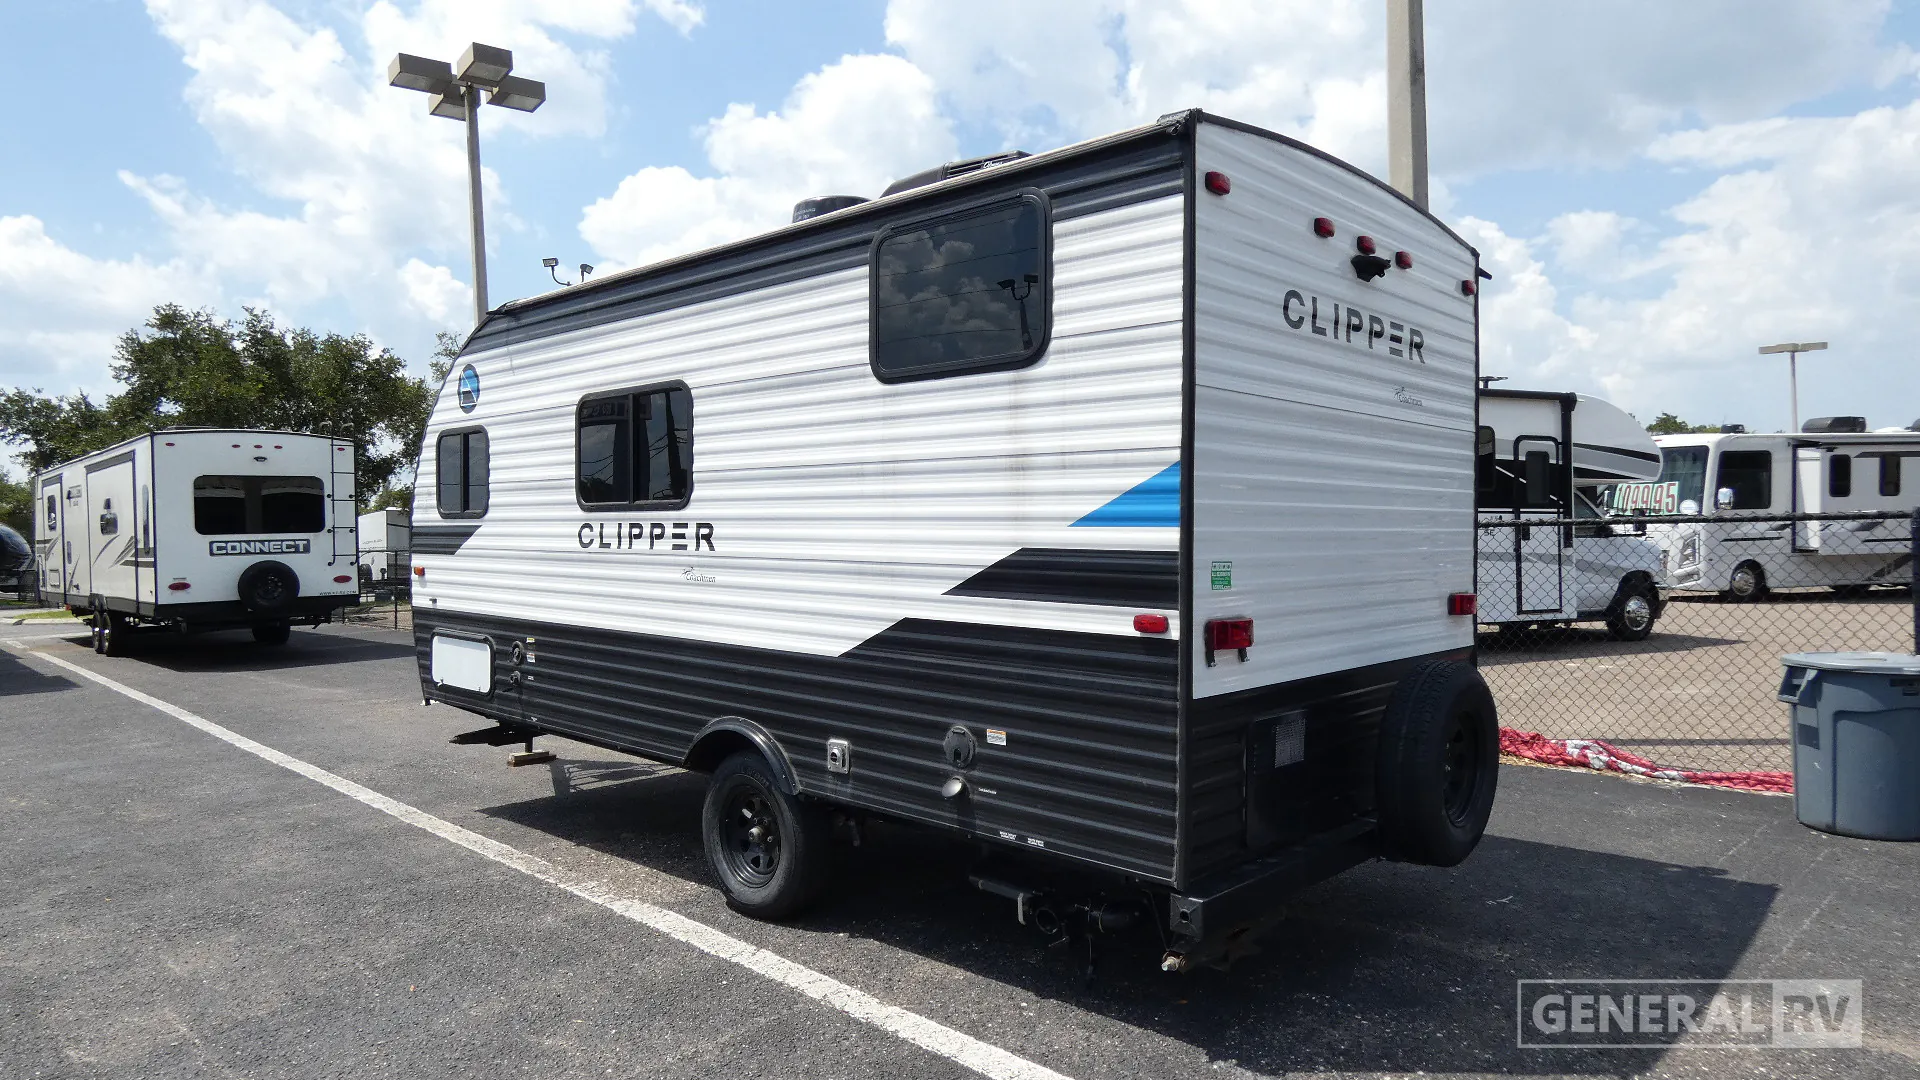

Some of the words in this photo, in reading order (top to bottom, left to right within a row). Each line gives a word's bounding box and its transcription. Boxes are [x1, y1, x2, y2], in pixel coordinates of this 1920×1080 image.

[1283, 289, 1426, 365] CLIPPER
[212, 540, 308, 555] CONNECT
[577, 522, 716, 552] CLIPPER
